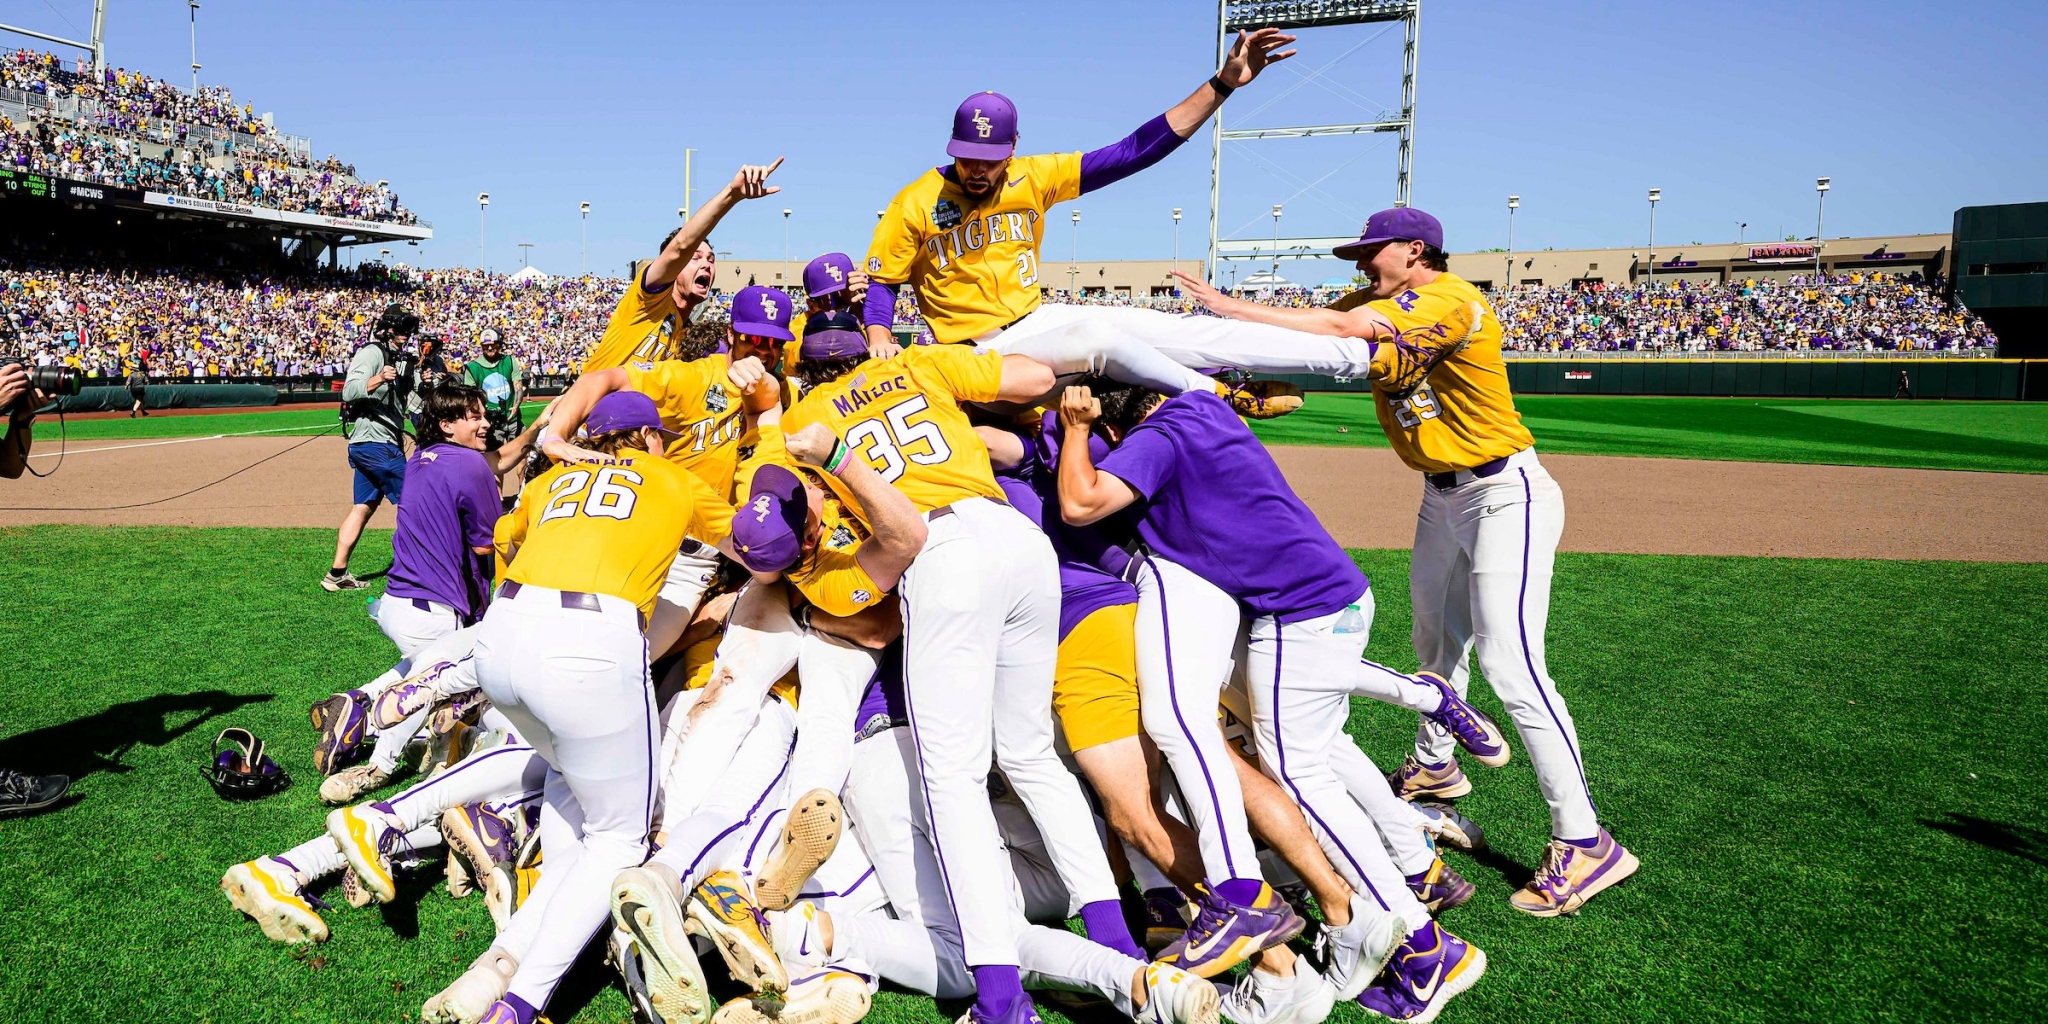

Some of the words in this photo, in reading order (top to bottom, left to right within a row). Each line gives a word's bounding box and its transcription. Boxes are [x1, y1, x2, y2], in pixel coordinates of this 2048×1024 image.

[972, 109, 993, 138] LSU
[5, 180, 18, 190] 10
[22, 181, 47, 190] STRIKE
[28, 174, 46, 183] BALL
[70, 186, 104, 199] #MCWS
[176, 198, 192, 206] MEN'S
[193, 201, 214, 209] COLLEGE
[927, 209, 1039, 271] TIGERS
[1779, 247, 1812, 256] ZONE
[824, 262, 842, 282] LSU
[761, 293, 778, 320] LSU
[1389, 389, 1442, 429] 29
[844, 392, 952, 485] 35
[537, 466, 644, 528] 26
[752, 495, 771, 523] LSU
